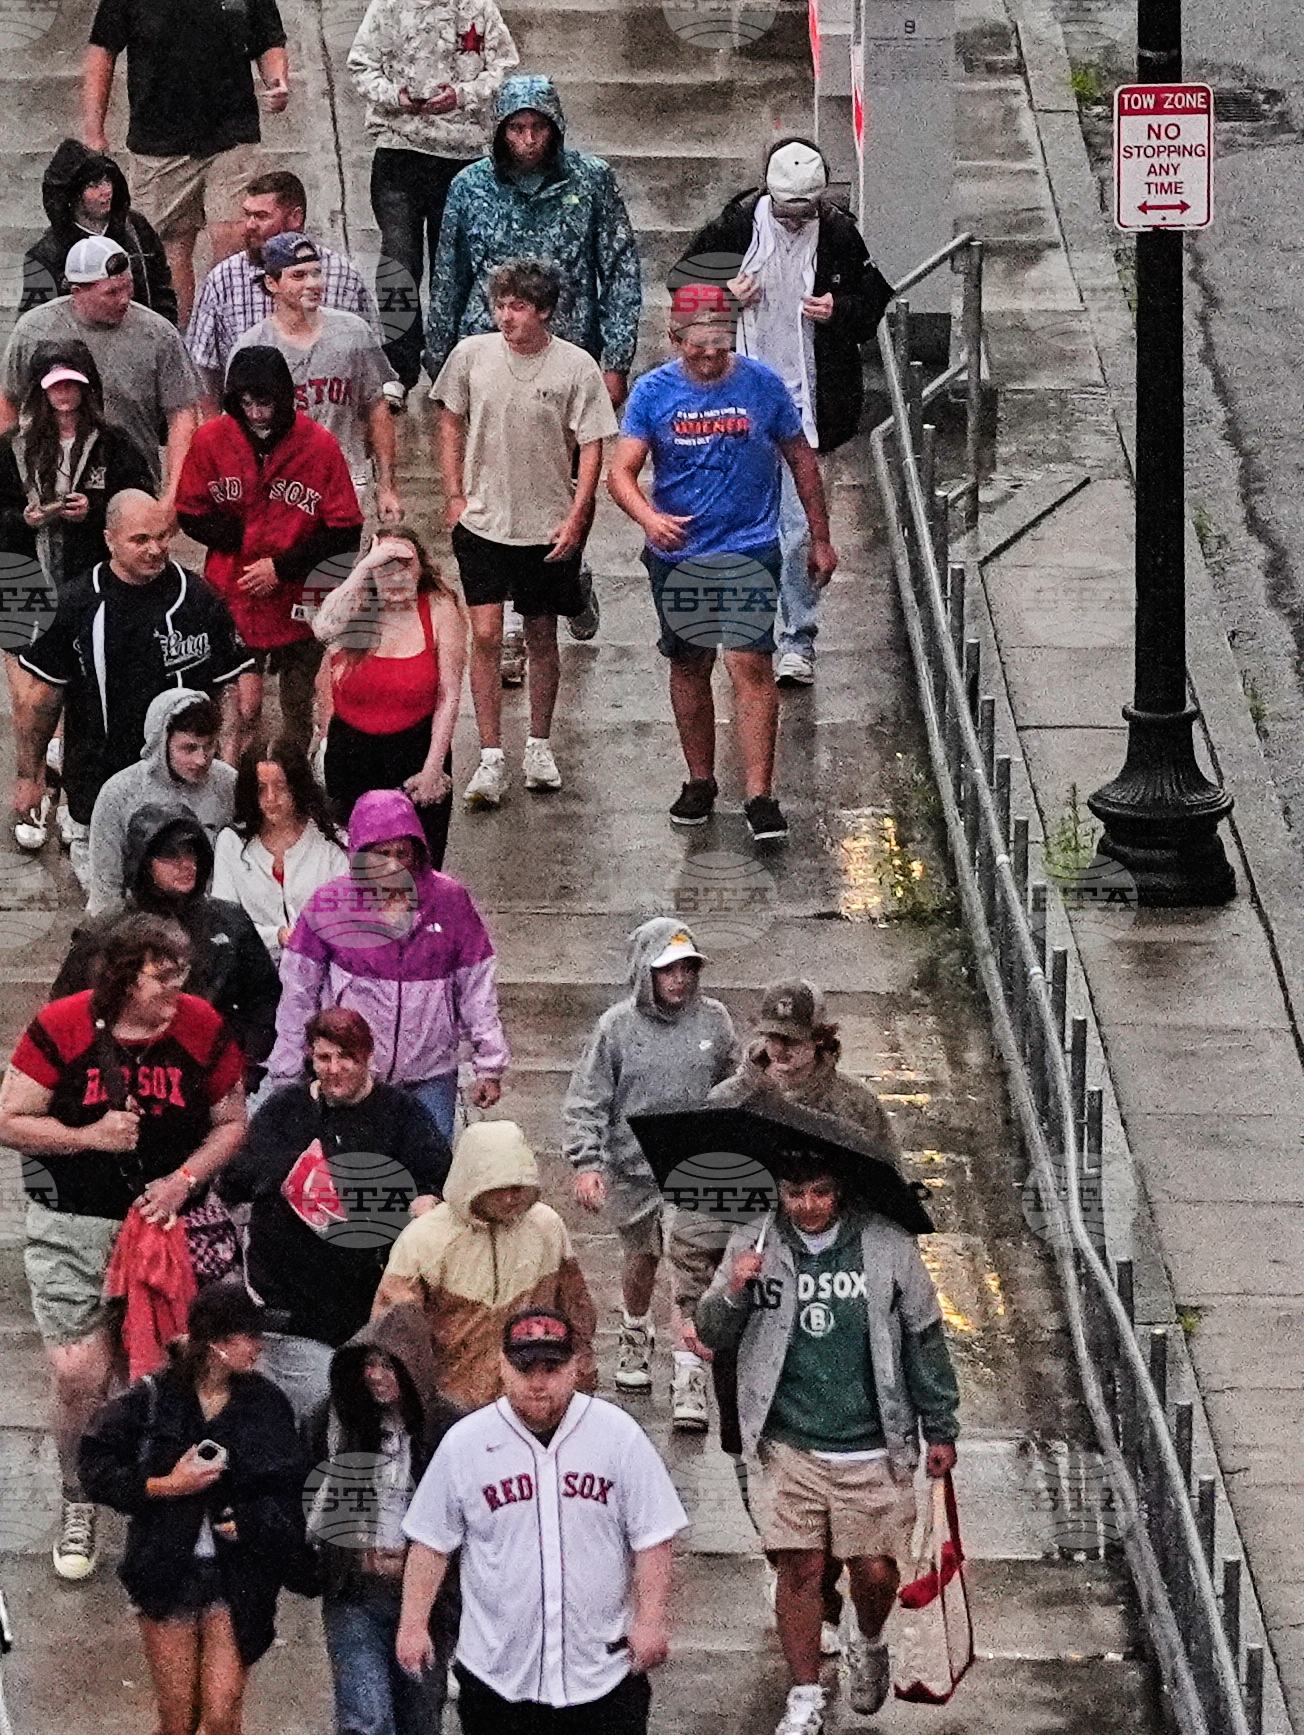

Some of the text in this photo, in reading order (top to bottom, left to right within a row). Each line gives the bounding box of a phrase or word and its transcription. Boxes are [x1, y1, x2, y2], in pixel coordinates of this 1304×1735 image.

[1122, 92, 1208, 110] TOW ZONE
[1147, 123, 1181, 140] NO
[1122, 144, 1206, 159] STOPPING
[1147, 163, 1181, 177] ANY
[1144, 182, 1184, 195] TIME
[269, 477, 323, 516] SOX
[482, 1471, 615, 1513] RED SOX
